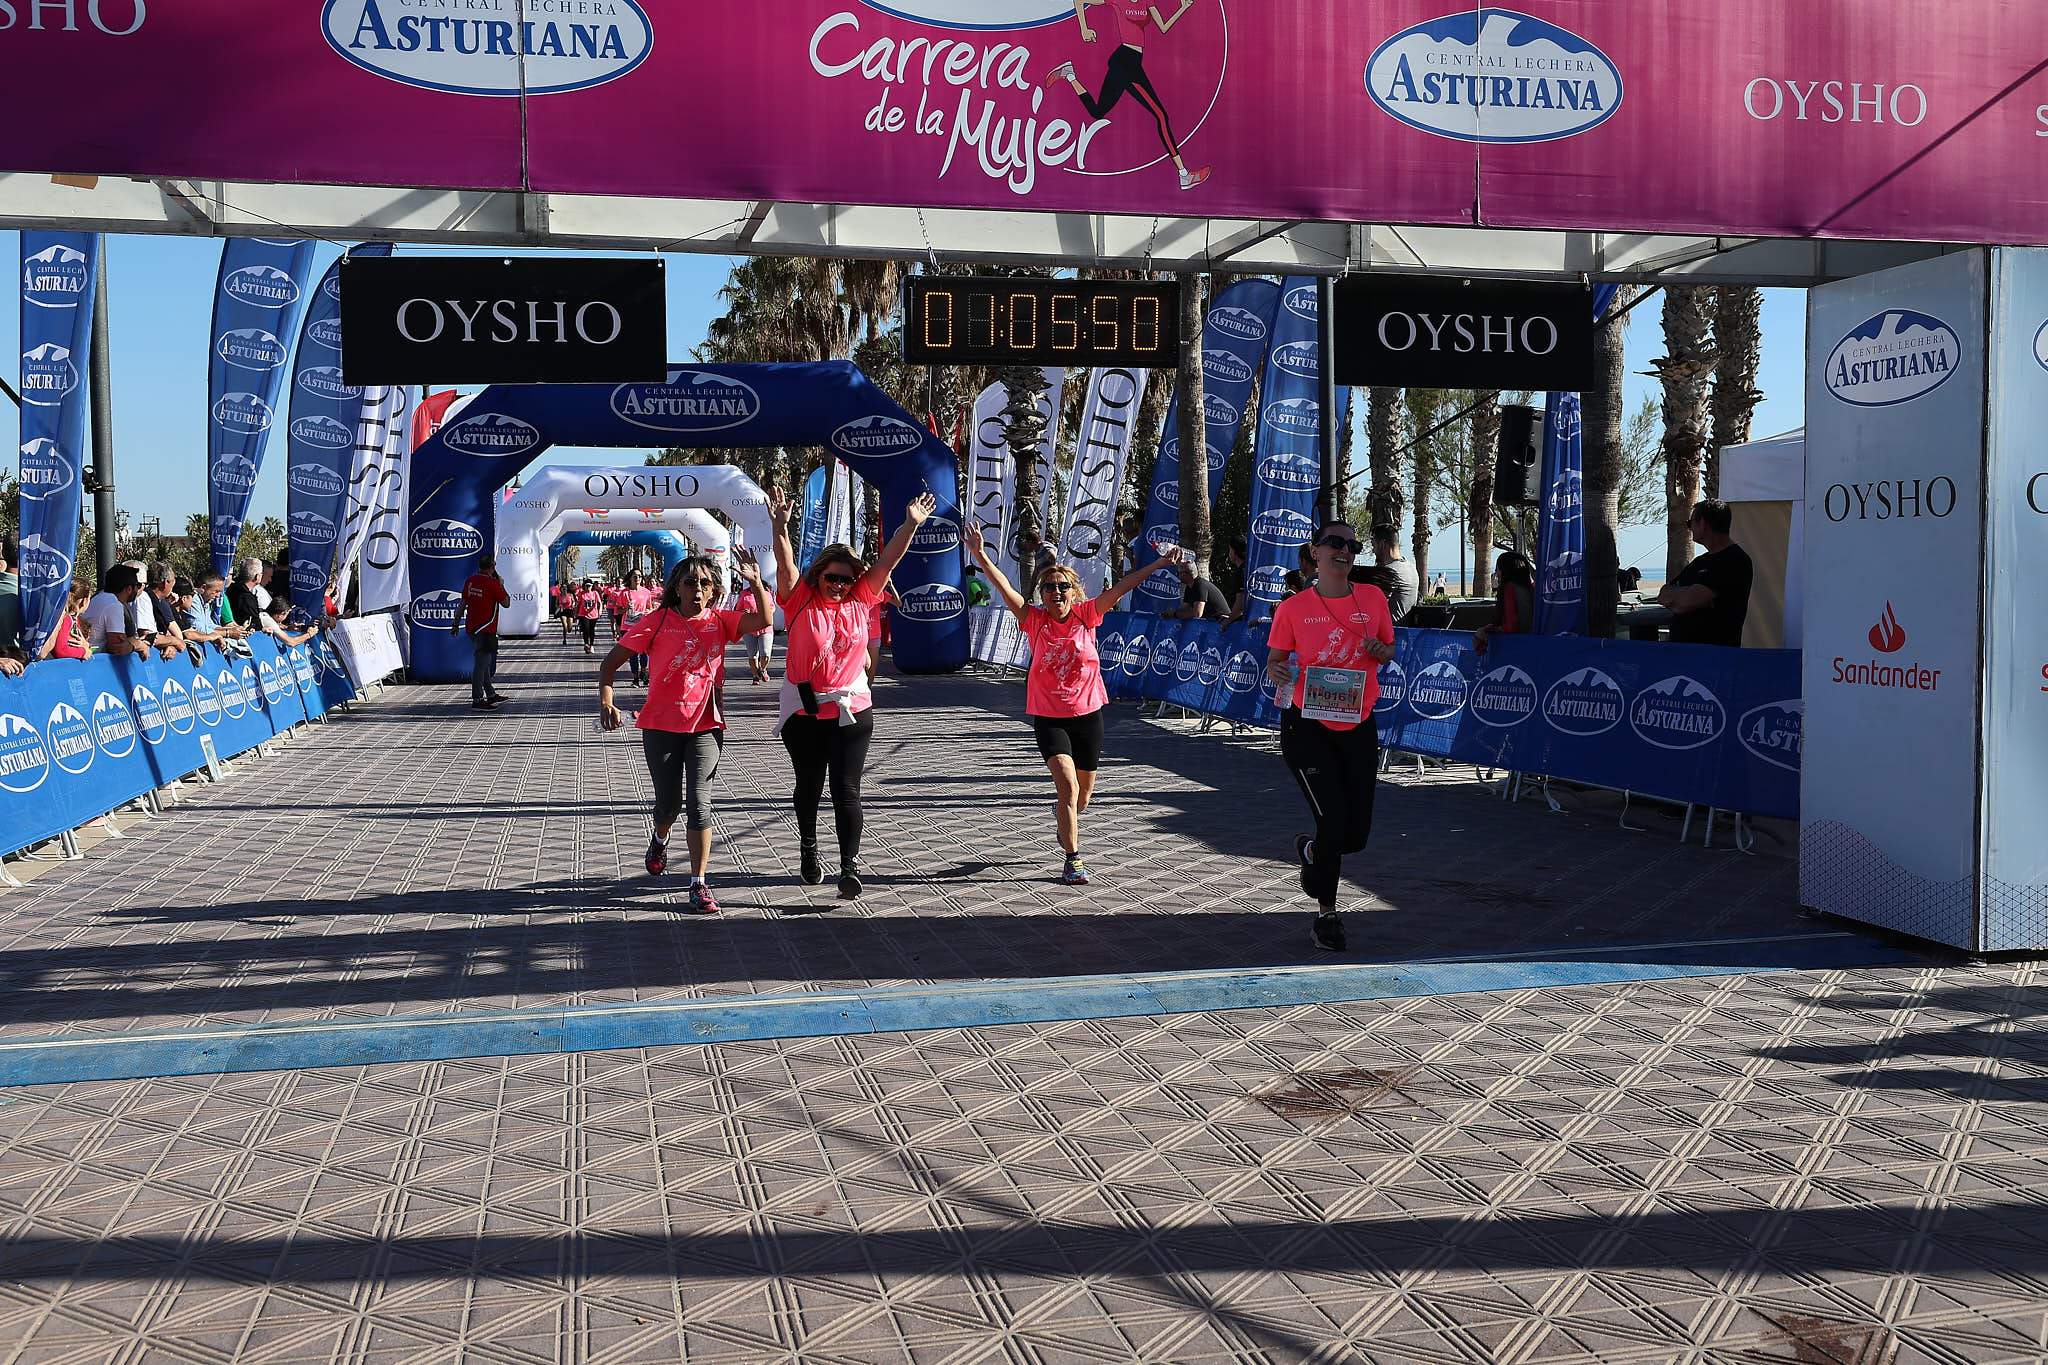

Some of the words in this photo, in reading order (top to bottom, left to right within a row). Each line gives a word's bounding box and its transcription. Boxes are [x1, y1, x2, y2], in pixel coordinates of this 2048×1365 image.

[348, 0, 630, 59] ASTURIANA
[809, 12, 1030, 91] Carrera
[1426, 52, 1506, 68] CENTRAL
[1514, 57, 1596, 72] LECHERA
[1385, 52, 1603, 111] ASTURIANA
[1743, 77, 1928, 127] OYSHO
[865, 87, 906, 134] de
[915, 87, 944, 136] la
[938, 86, 1112, 195] Mujer
[396, 298, 622, 344] OYSHO
[925, 291, 1159, 351] 01:05:50
[1211, 312, 1261, 337] ASTURIANA
[1377, 311, 1558, 355] OYSHO
[1852, 343, 1893, 358] CENTRAL
[1898, 334, 1945, 350] LECHERA
[1833, 348, 1950, 388] ASTURIANA
[622, 388, 750, 416] ASTURIANA
[645, 387, 693, 395] CENTRAL
[696, 388, 744, 396] LECHERA
[294, 423, 348, 445] ASTURIANA
[449, 429, 532, 446] ASTURIANA
[839, 432, 918, 448] ASTURIANA
[1066, 368, 1137, 559] OYSHO
[289, 471, 341, 492] ASTURIANA
[584, 474, 699, 498] OYSHO
[515, 501, 551, 509] OYSHO
[1824, 476, 1957, 522] OYSHO
[413, 533, 478, 548] ASTURIANA
[901, 598, 962, 613] ASTURIANA
[1832, 657, 1941, 691] Santander
[1411, 680, 1461, 706] ASTURIANA
[1474, 686, 1530, 713] ASTURIANA
[1547, 690, 1617, 721] ASTURIANA
[1635, 698, 1714, 736] ASTURIANA
[52, 732, 93, 760] ASTURIANA
[96, 720, 134, 745] ASTURIANA
